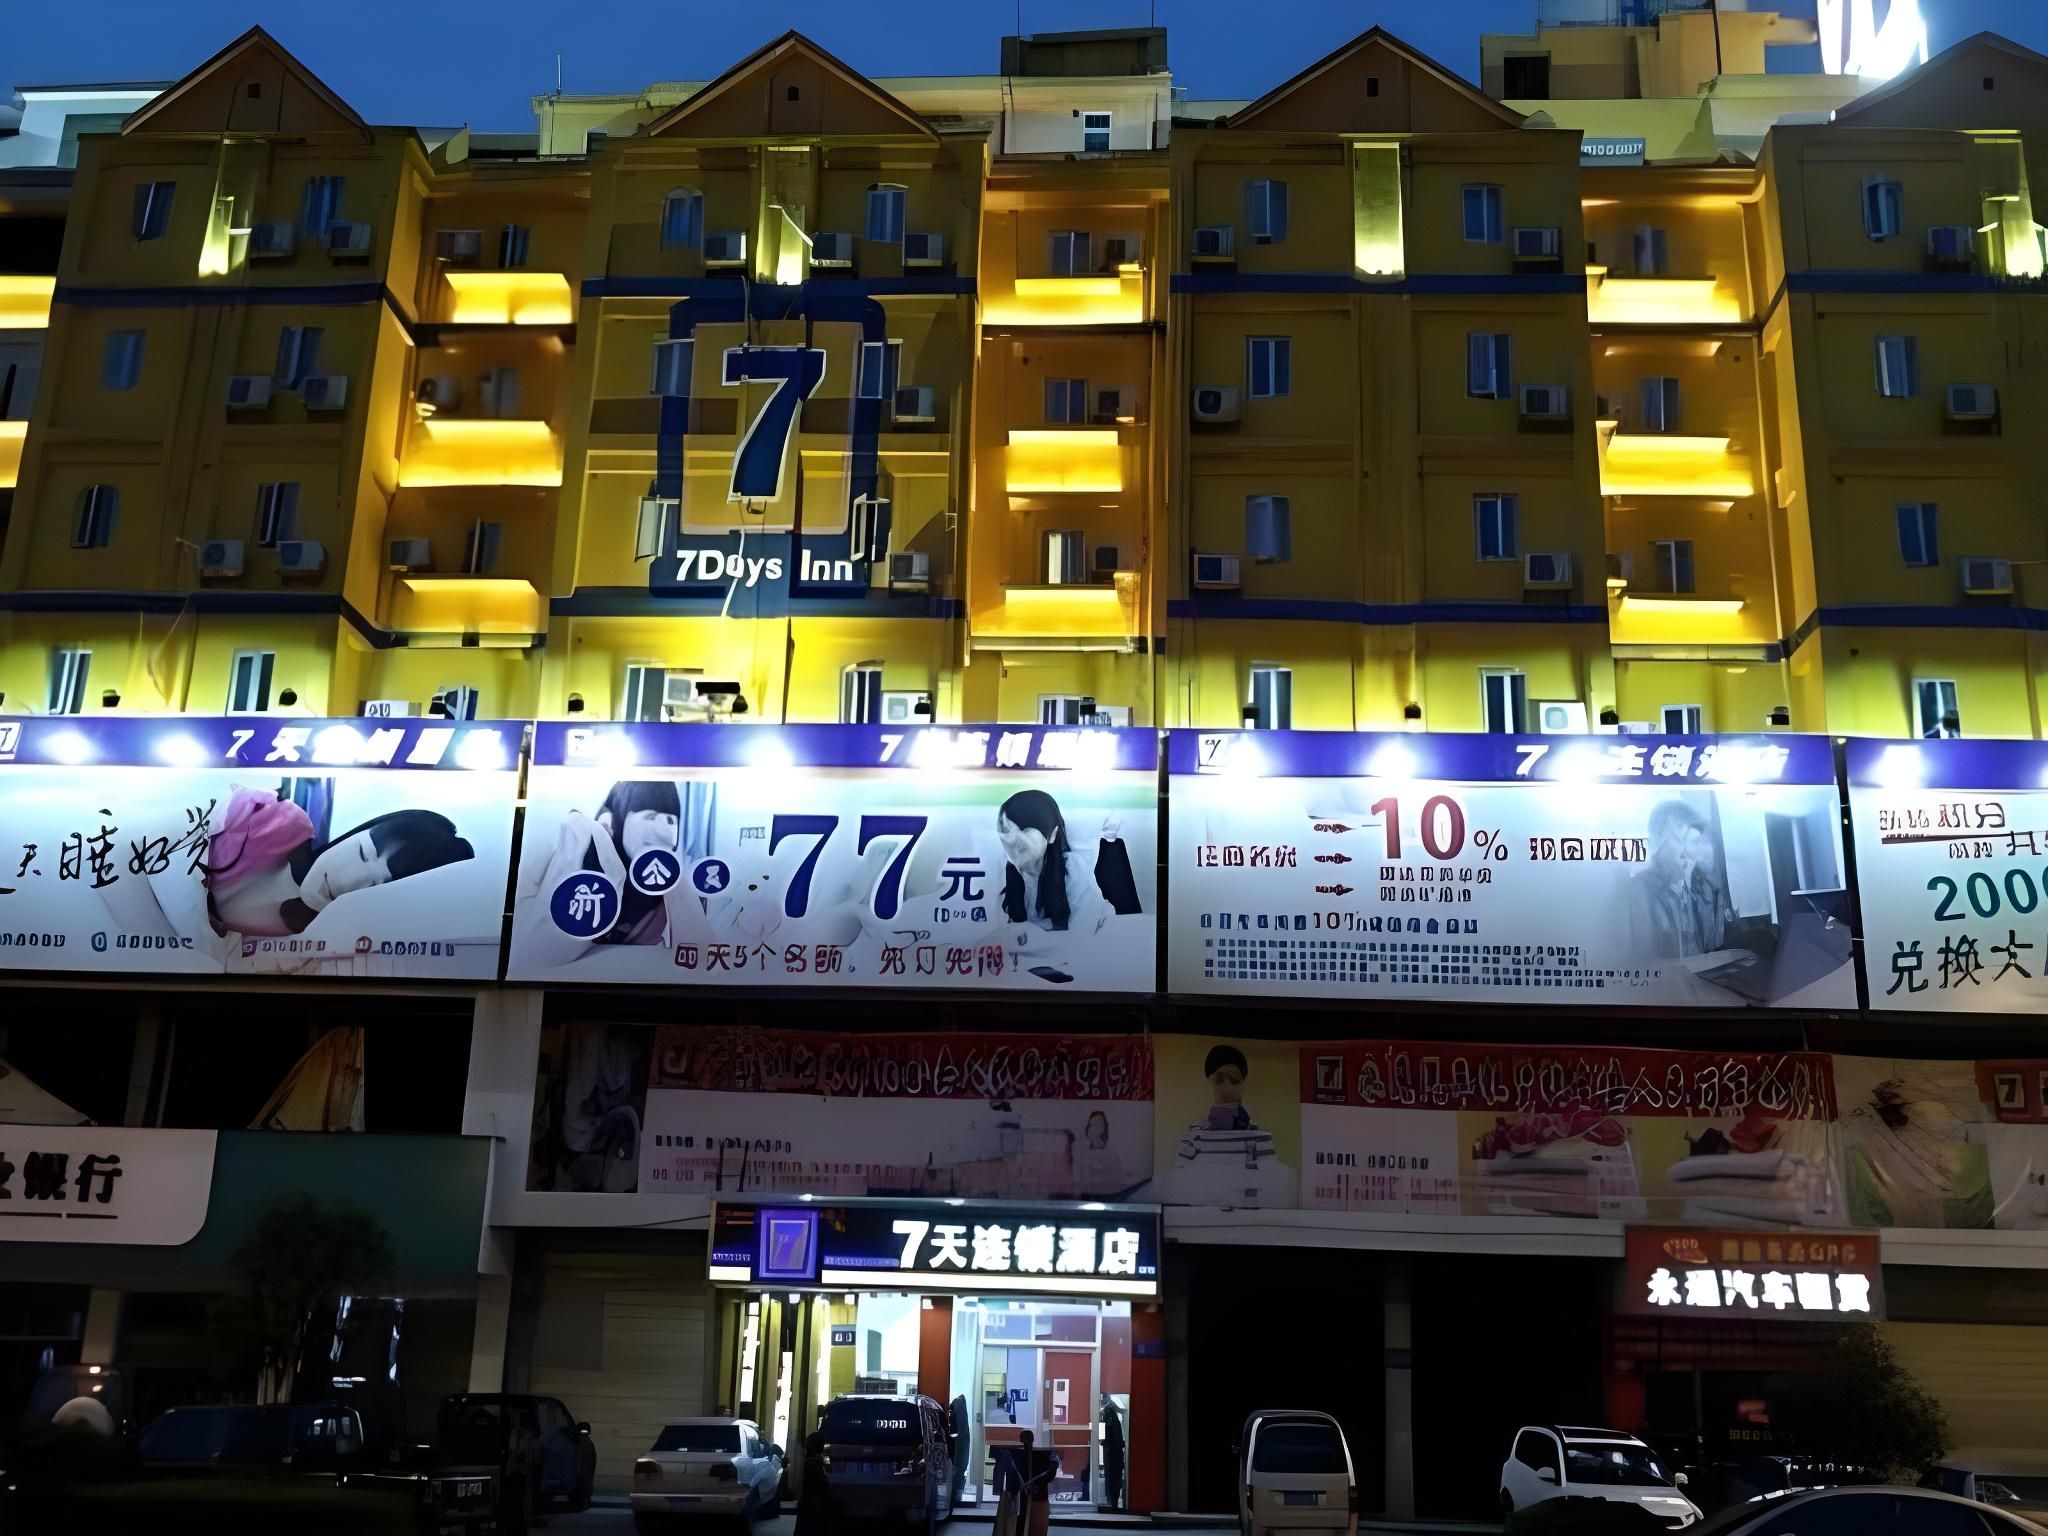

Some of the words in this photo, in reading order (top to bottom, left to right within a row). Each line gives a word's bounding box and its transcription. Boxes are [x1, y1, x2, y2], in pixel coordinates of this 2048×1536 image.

[721, 346, 827, 504] 7
[800, 549, 853, 581] Inn
[0, 799, 246, 894] 天睡好觉
[1926, 866, 2048, 921] 200
